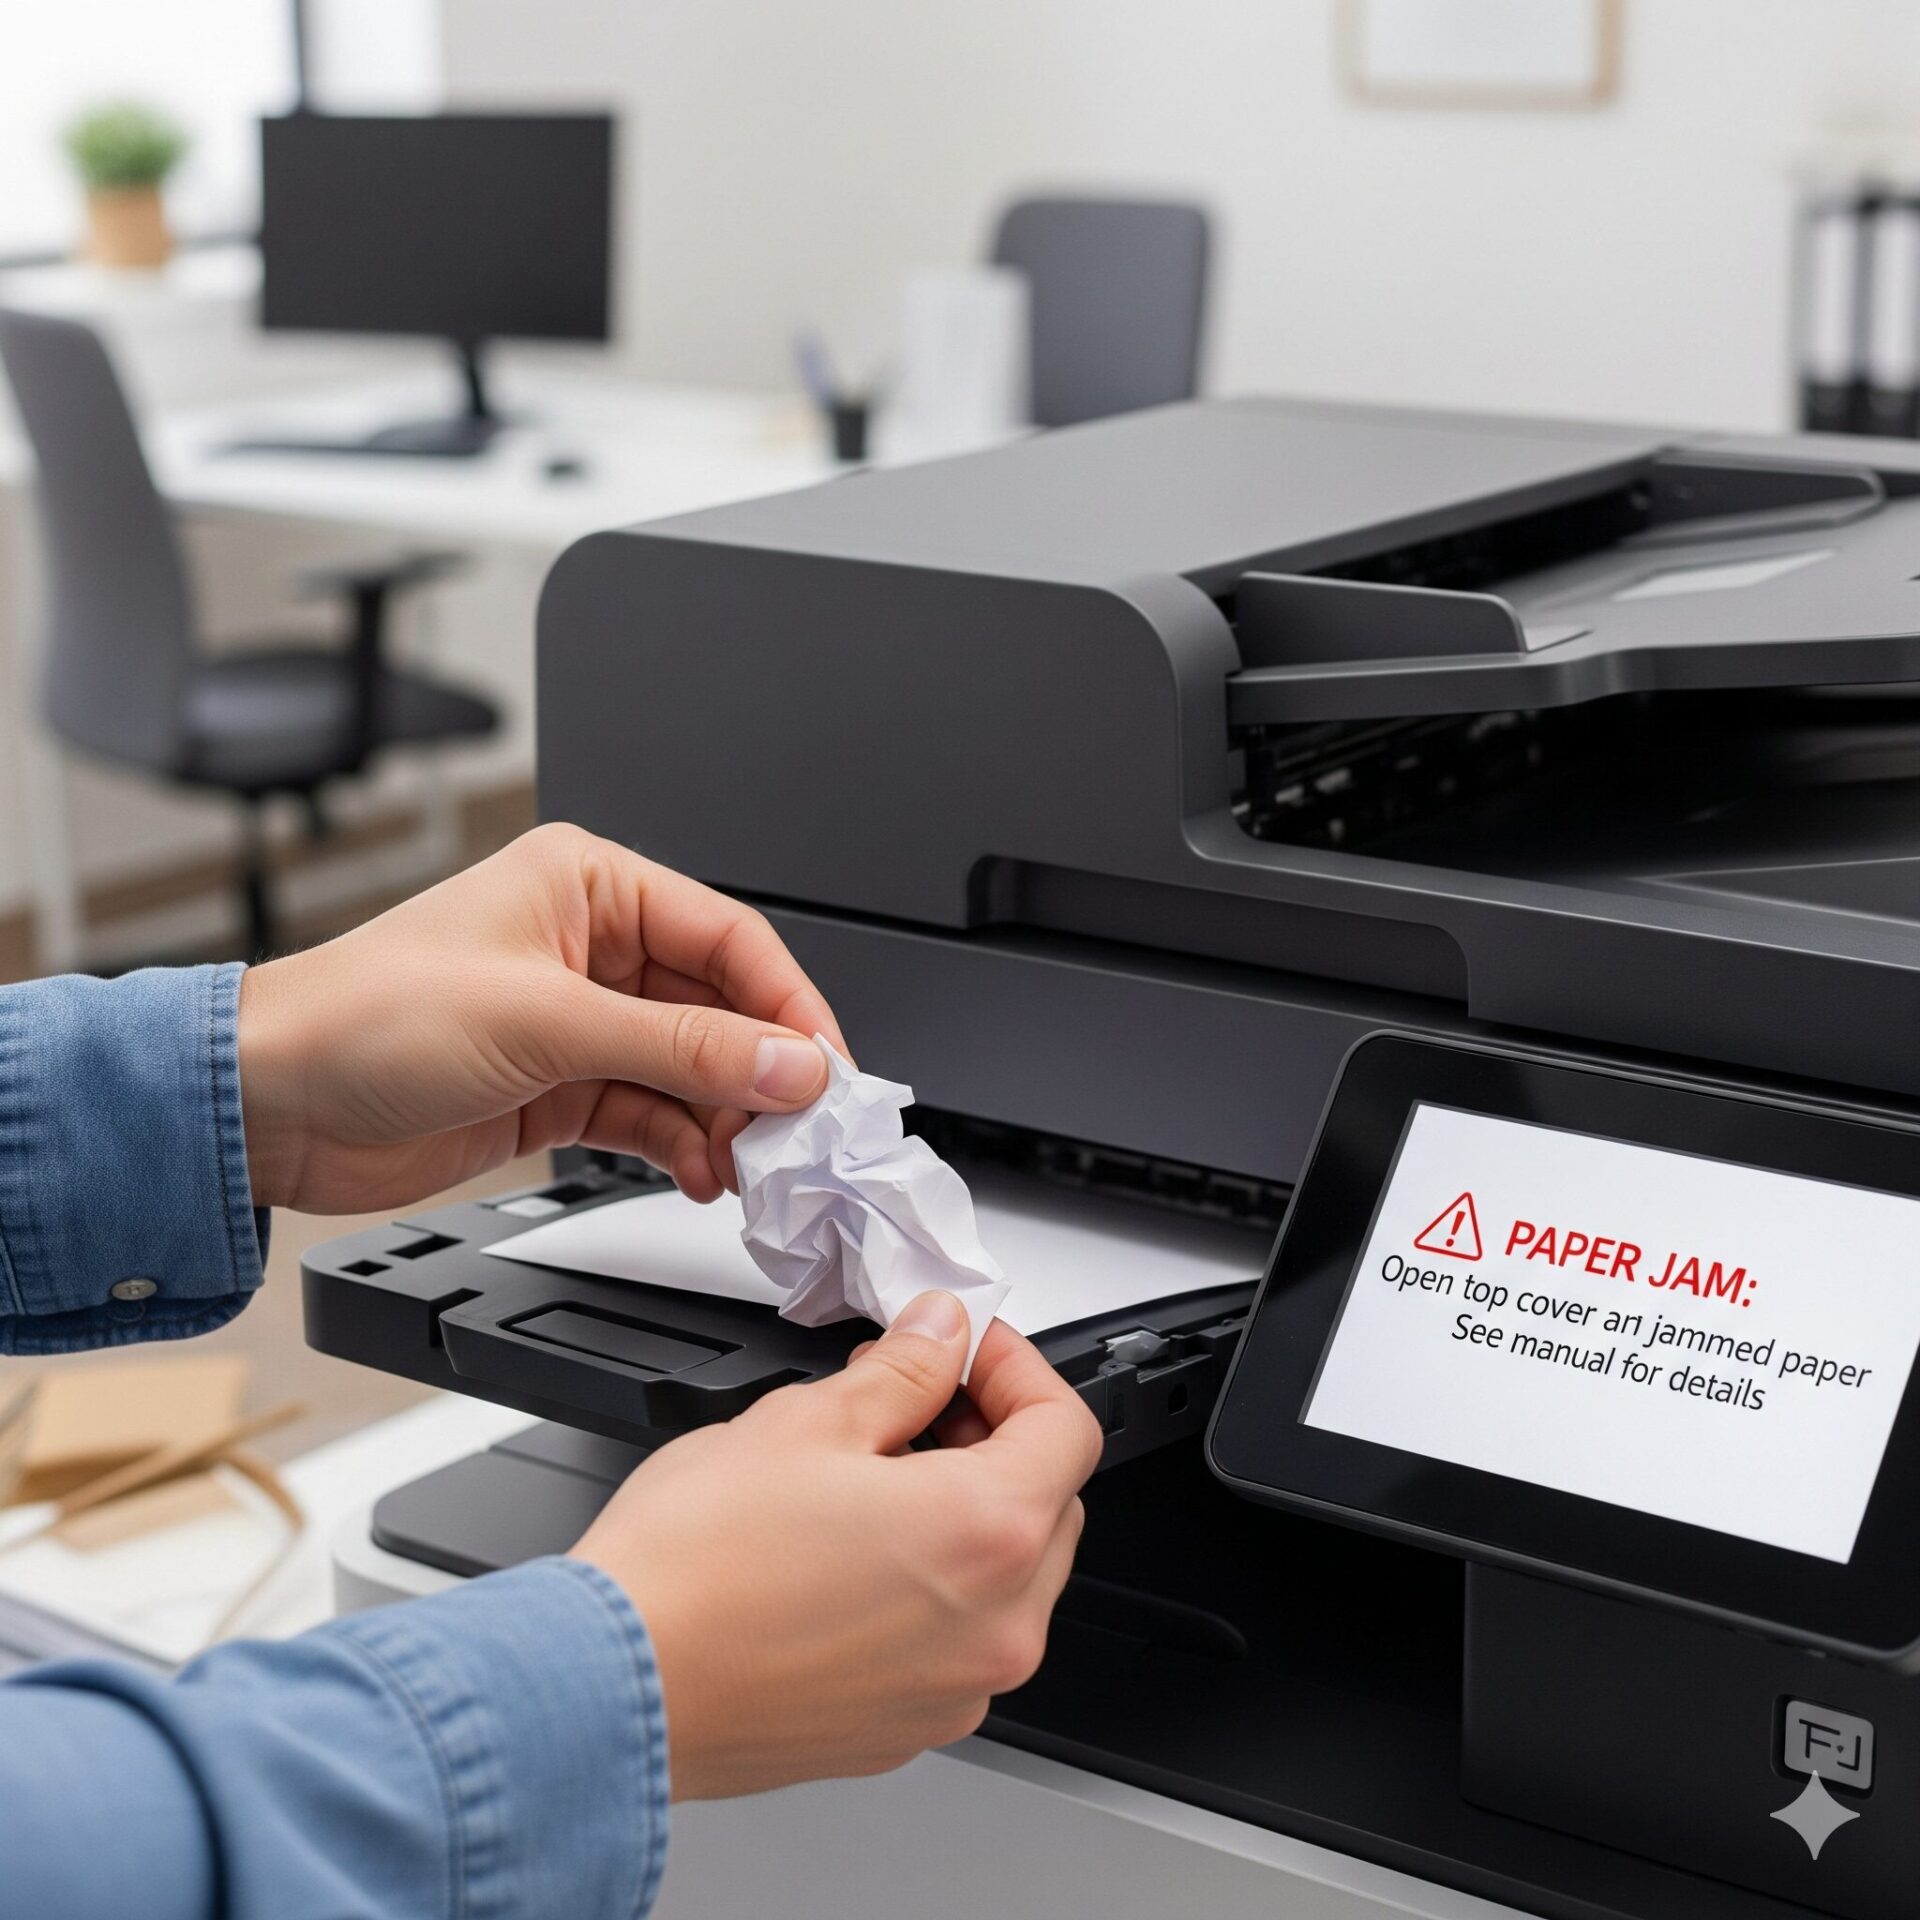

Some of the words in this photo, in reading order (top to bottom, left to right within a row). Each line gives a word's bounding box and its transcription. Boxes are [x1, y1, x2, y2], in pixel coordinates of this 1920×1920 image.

[1504, 1219, 1642, 1283] PAPER
[1648, 1252, 1758, 1308] JAM:
[1381, 1254, 1454, 1295] Open
[1463, 1274, 1509, 1313] top
[1516, 1292, 1598, 1326] cover
[1641, 1314, 1776, 1367] jammed
[1777, 1351, 1873, 1388] paper
[1451, 1313, 1504, 1349] See
[1510, 1332, 1617, 1375] manual
[1620, 1352, 1664, 1386] for
[1668, 1365, 1767, 1411] details
